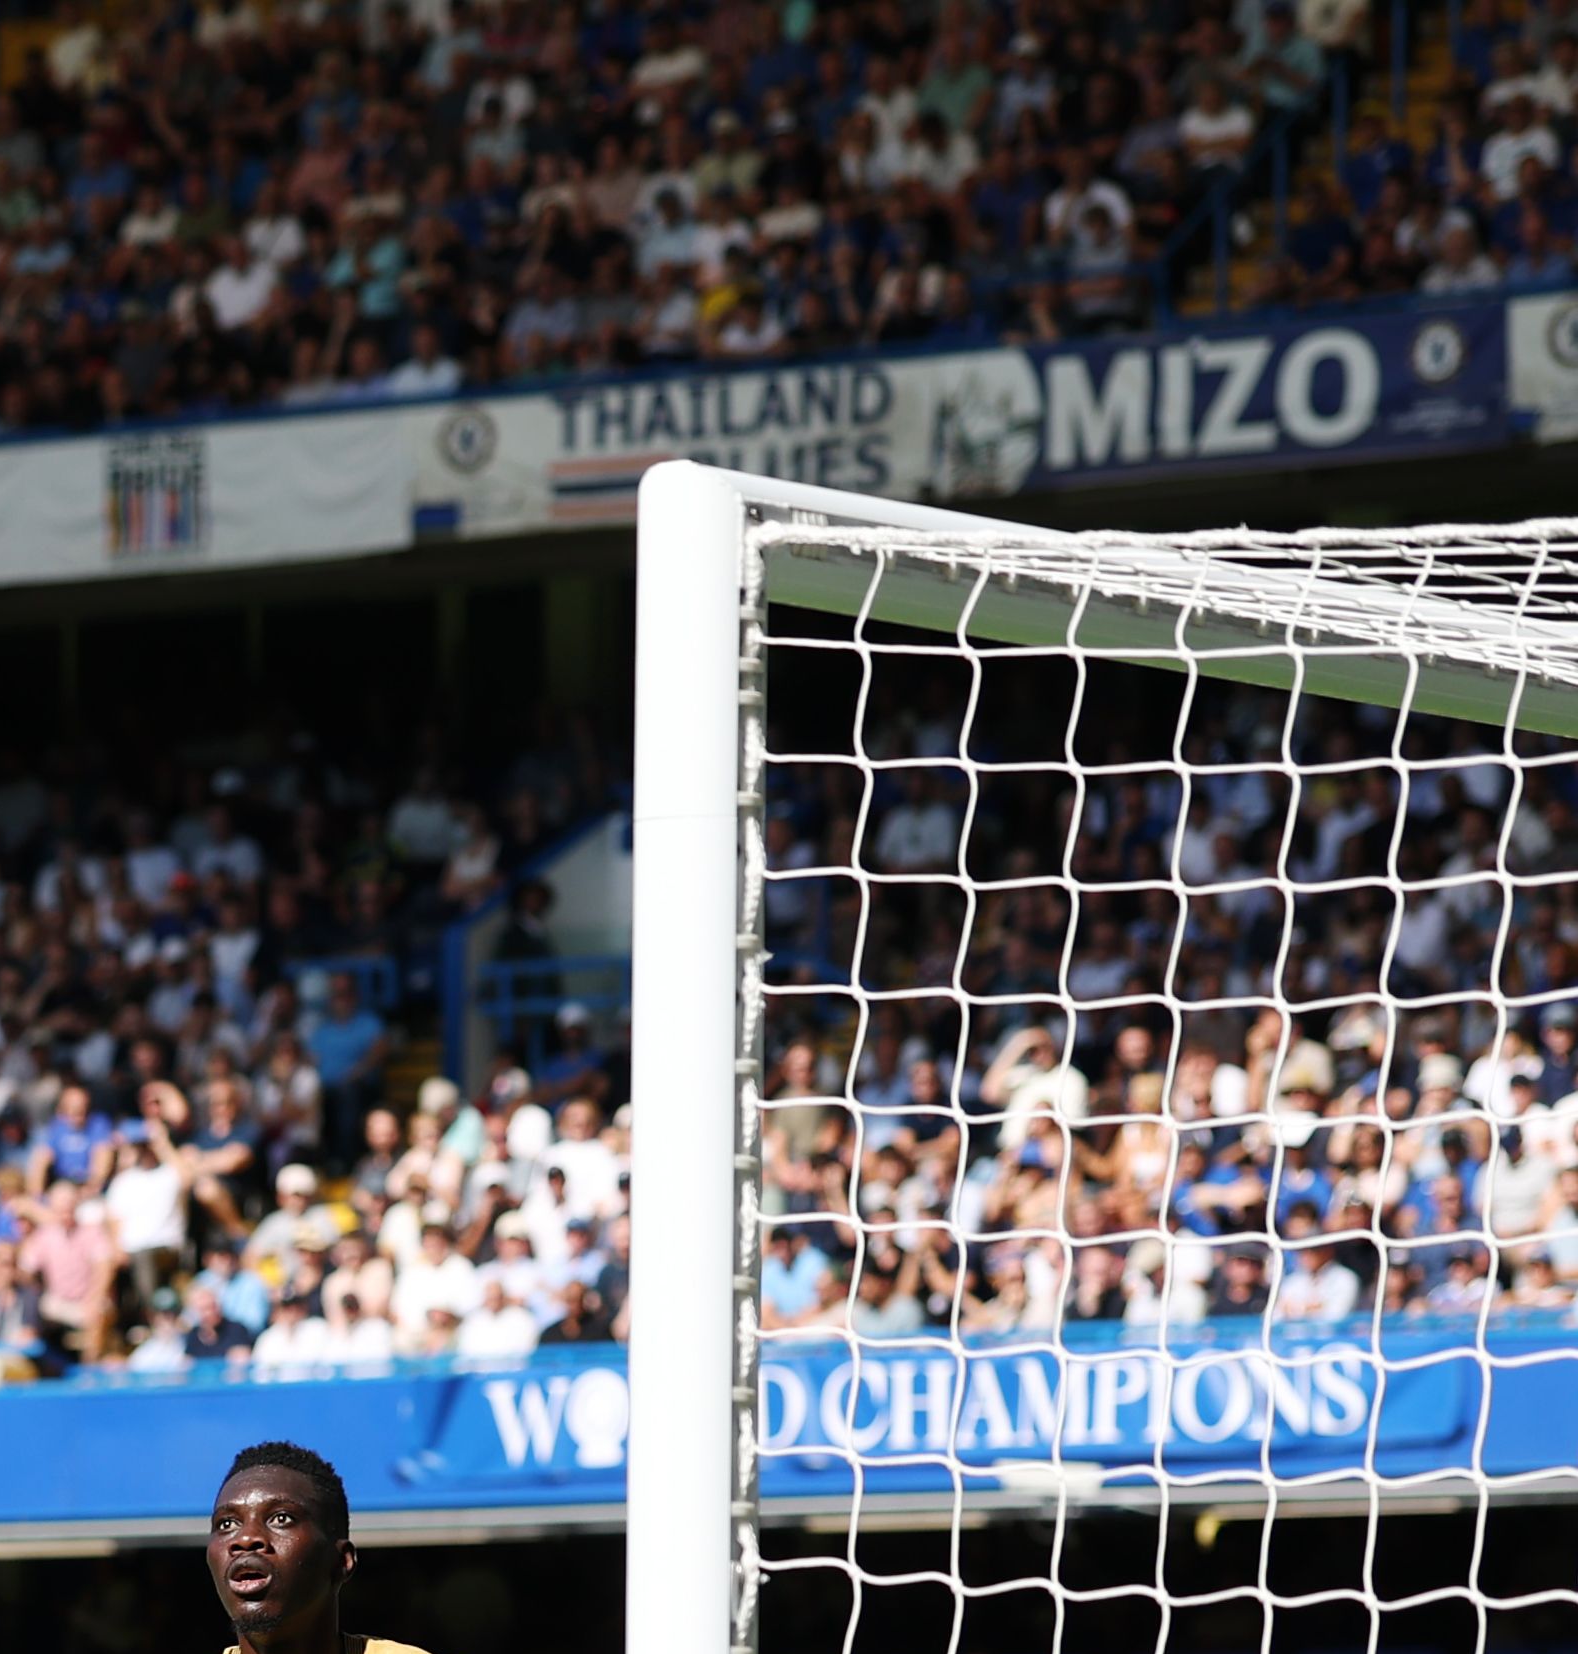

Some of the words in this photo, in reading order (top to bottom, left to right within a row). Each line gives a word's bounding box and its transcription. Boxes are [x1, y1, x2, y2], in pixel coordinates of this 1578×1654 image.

[550, 366, 895, 448] THAILAND
[1047, 327, 1380, 470] MIZO
[819, 1342, 1367, 1453] CHAMPIONS
